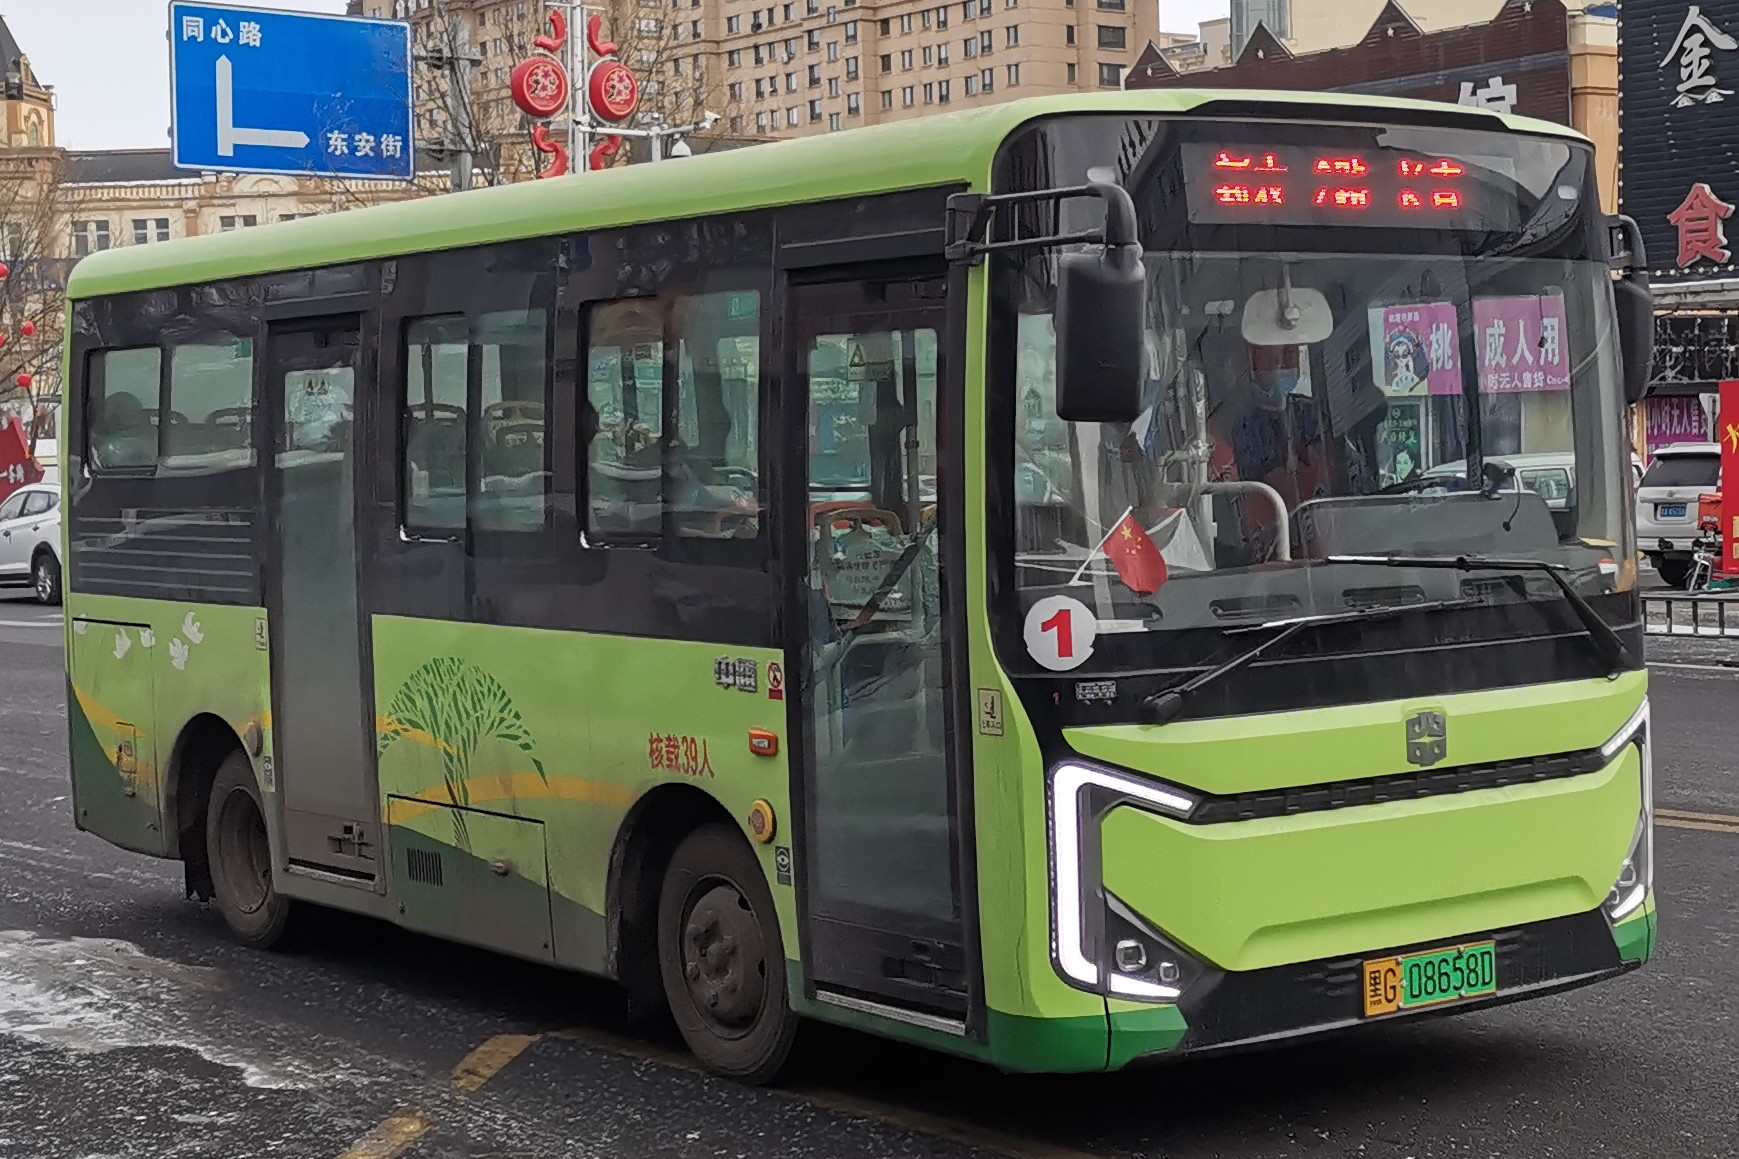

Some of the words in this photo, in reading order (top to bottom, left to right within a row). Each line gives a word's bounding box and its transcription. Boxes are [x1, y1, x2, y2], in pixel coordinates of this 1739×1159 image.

[182, 16, 262, 47] 同心路
[327, 130, 403, 159] 东安街
[1667, 183, 1735, 267] 食
[1647, 397, 1708, 437] 小时无人售
[1041, 609, 1073, 658] 1
[1369, 968, 1397, 1003] 黑G
[1408, 950, 1494, 999] 08658D
